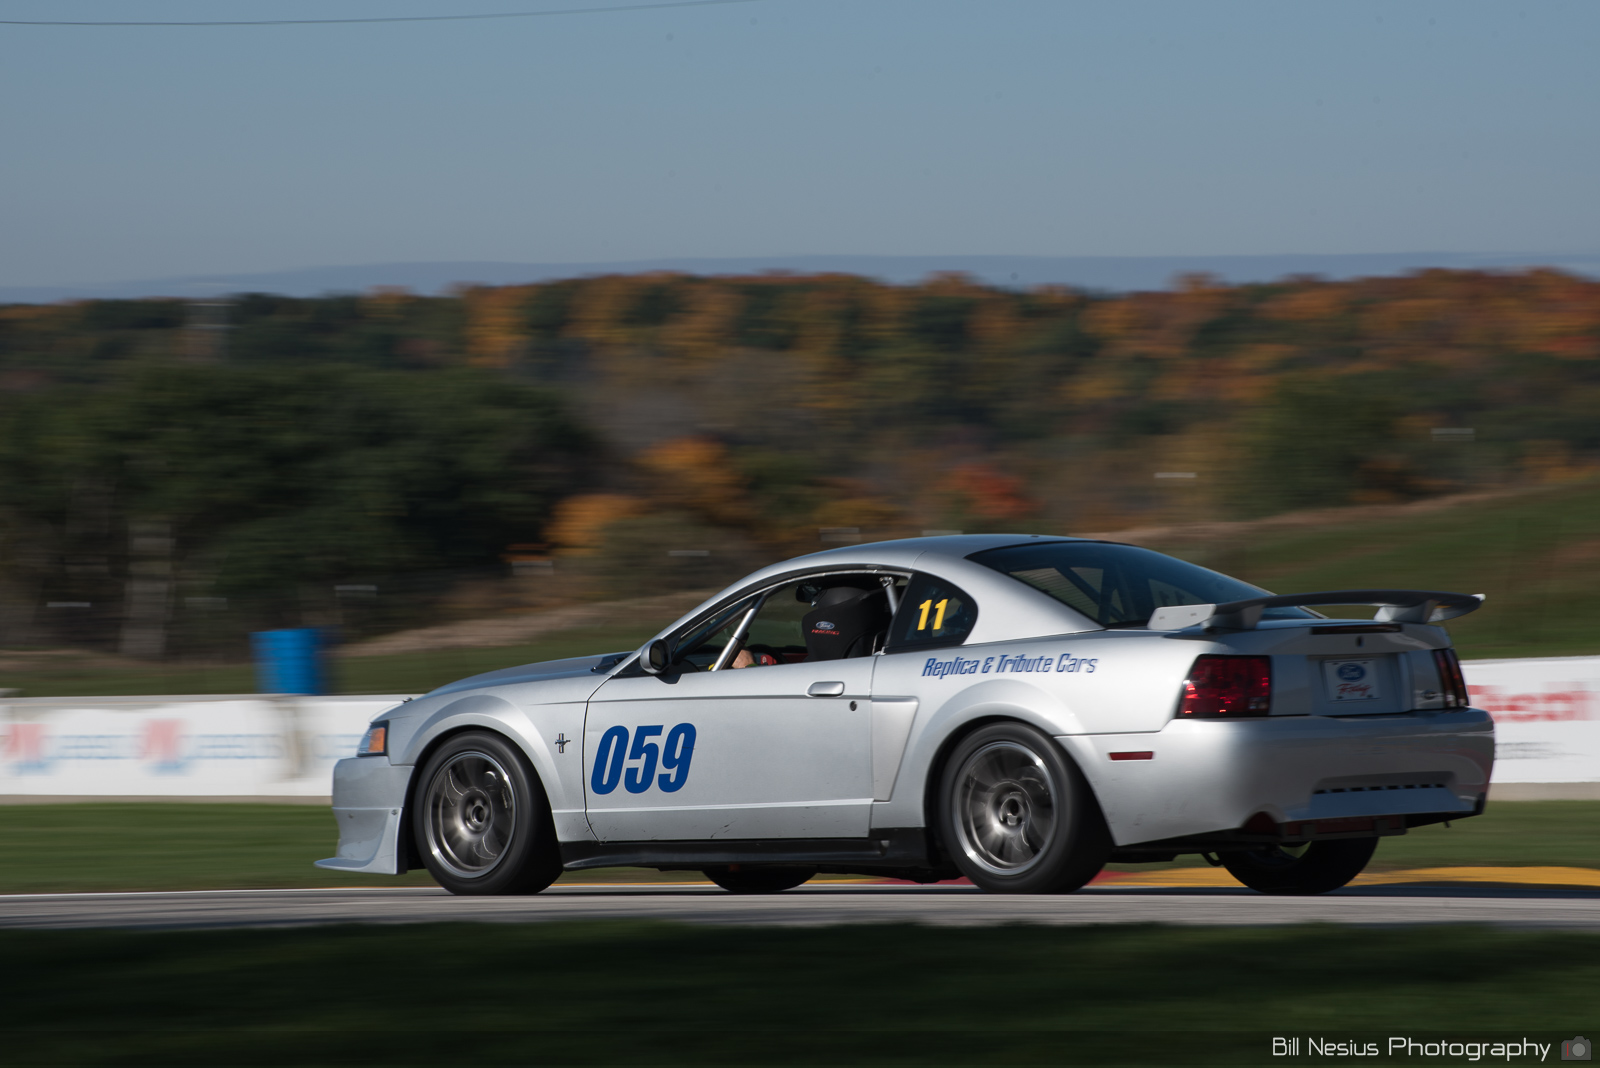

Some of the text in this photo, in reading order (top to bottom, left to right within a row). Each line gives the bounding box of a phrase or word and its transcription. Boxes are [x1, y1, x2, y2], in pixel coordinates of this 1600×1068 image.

[917, 598, 949, 631] 11
[921, 653, 1099, 680] Replica & Tribute Cars
[591, 723, 697, 795] 059
